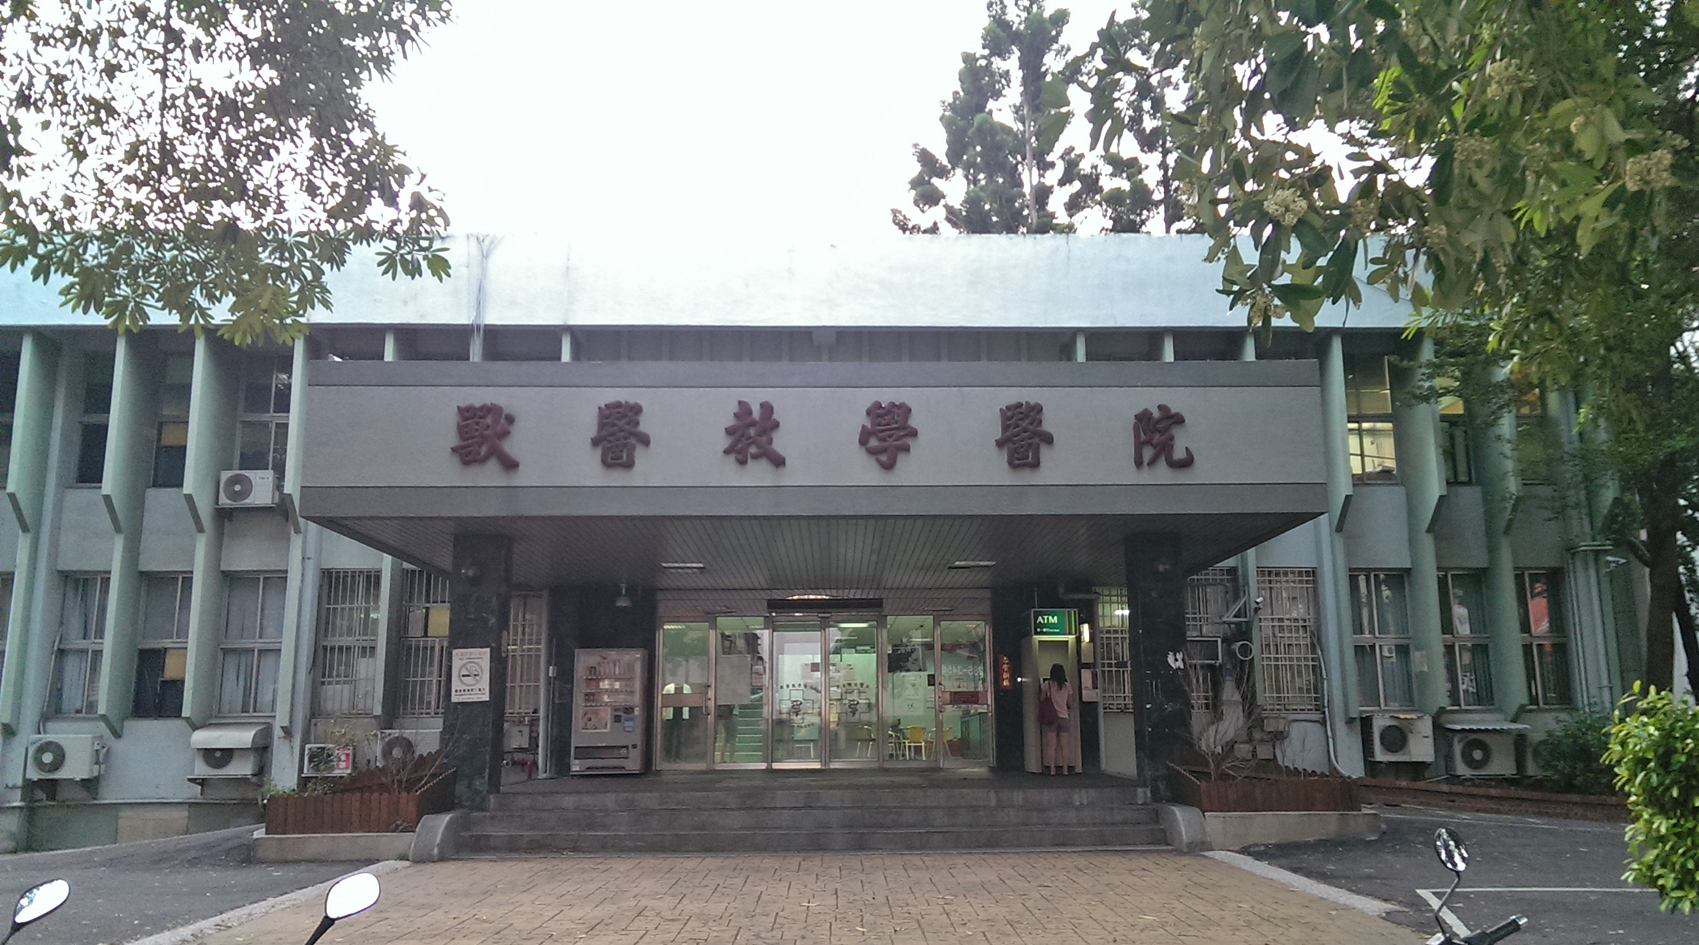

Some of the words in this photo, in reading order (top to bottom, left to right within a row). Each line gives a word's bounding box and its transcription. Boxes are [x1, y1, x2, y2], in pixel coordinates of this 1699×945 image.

[451, 401, 1194, 469] 獸醫教學醫院
[1036, 615, 1058, 624] ATM
